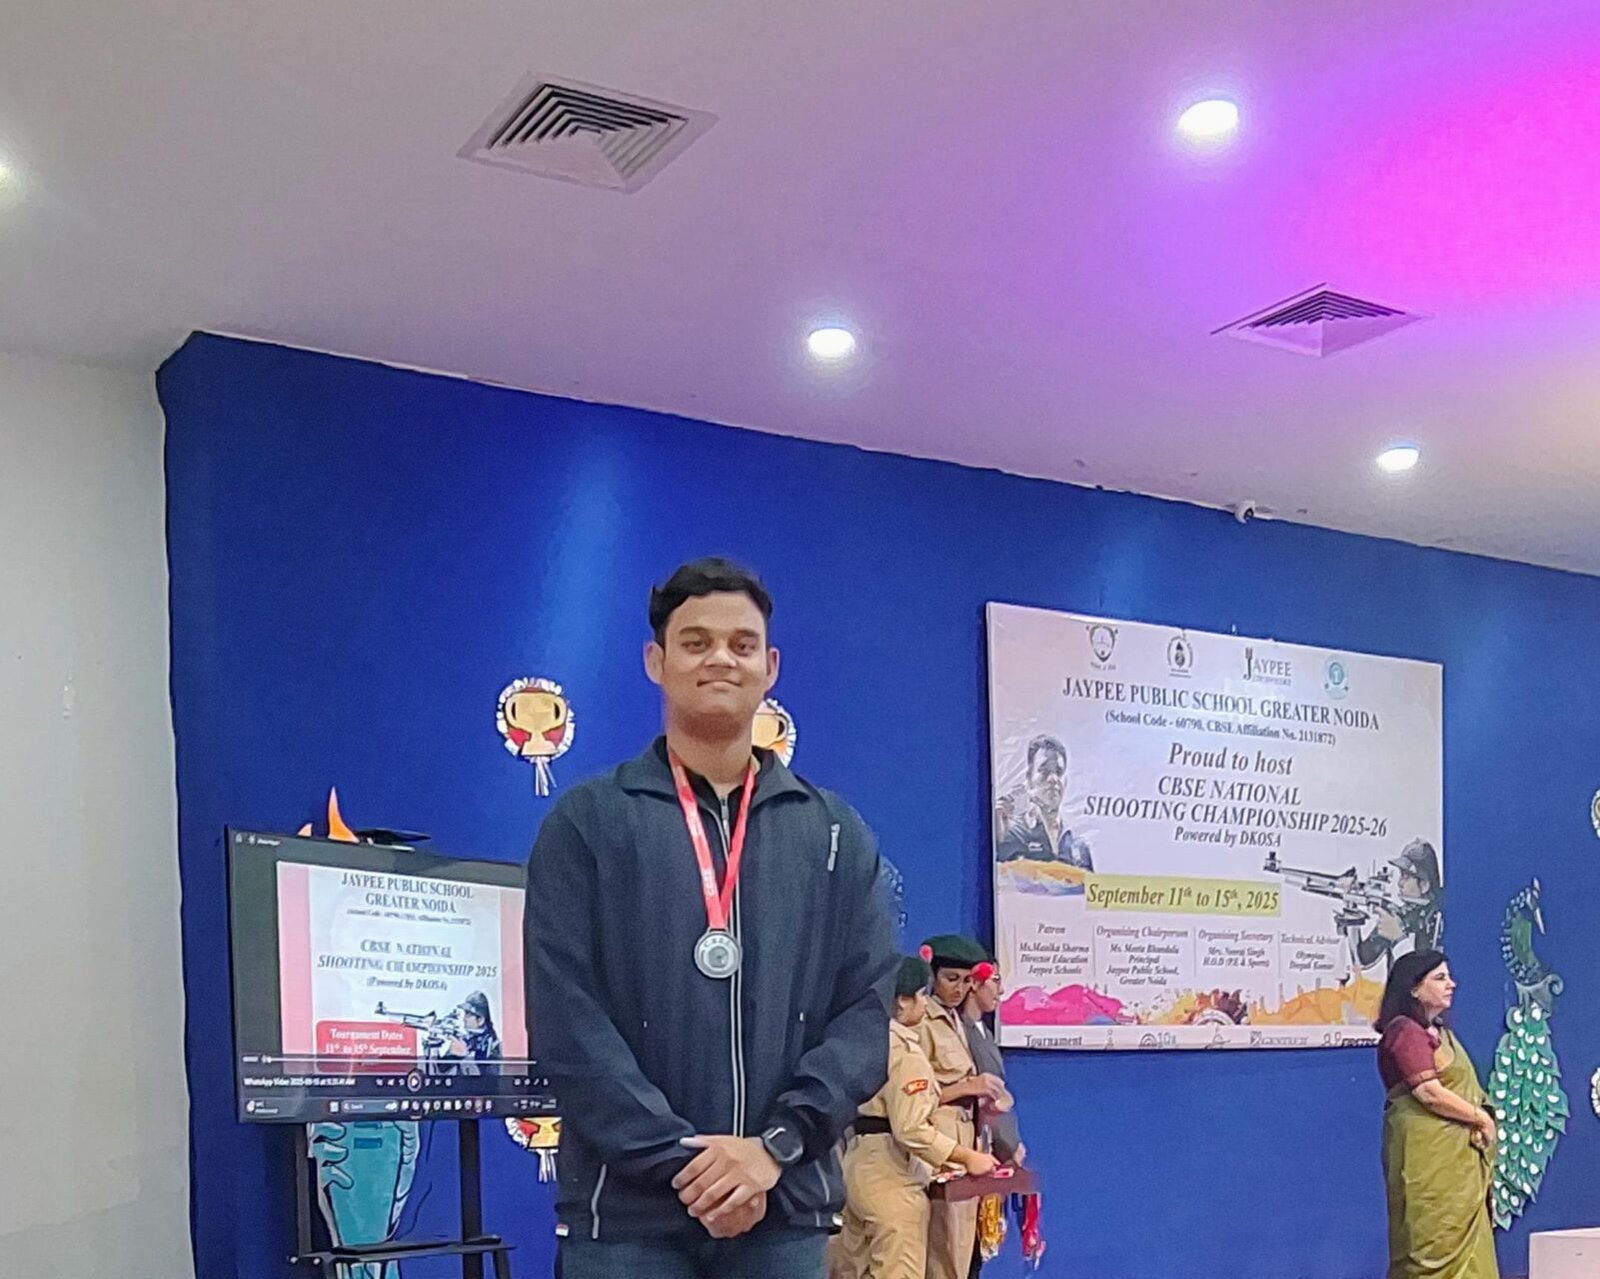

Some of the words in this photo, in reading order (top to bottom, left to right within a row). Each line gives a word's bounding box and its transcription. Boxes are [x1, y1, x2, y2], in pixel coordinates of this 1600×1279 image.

[1243, 648, 1292, 680] JAYPEE
[1062, 676, 1127, 702] JAYPEE
[1130, 684, 1189, 709] PUBLIC
[1192, 691, 1257, 716] SCHOOL
[1260, 699, 1330, 725] GREATER
[1333, 707, 1379, 730] NOIDA
[1105, 709, 1140, 725] (School
[1143, 713, 1167, 727] Code
[1207, 720, 1234, 734] CBSE
[1236, 723, 1280, 738] Affiliation
[1282, 728, 1297, 740] No.
[1169, 742, 1227, 769] Proud
[1231, 751, 1249, 771] to
[1254, 750, 1293, 775] host
[1158, 775, 1207, 798] CBSE
[1209, 780, 1301, 806] NATIONAL
[1083, 795, 1187, 821] SHOOTING
[1191, 804, 1329, 831] CHAMPIONSHIP
[1331, 814, 1388, 837] 2025-26
[1175, 826, 1222, 843] Powered
[1224, 828, 1237, 848] by
[1239, 830, 1281, 847] DKOSA
[341, 872, 385, 890] JAYPEE
[387, 878, 428, 895] PUBLIC
[430, 882, 474, 900] SCHOOL
[1088, 883, 1164, 909] September
[1168, 886, 1193, 906] 11th
[1196, 891, 1210, 907] to
[1245, 890, 1279, 910] 2025
[365, 892, 420, 910] GREATER
[422, 898, 457, 914] NOIDA
[1037, 923, 1065, 934] Patron
[317, 955, 383, 971] SHOOTING
[475, 965, 498, 978] 2025
[1020, 954, 1051, 963] Director
[1052, 954, 1089, 964] Education
[1128, 954, 1160, 967] Principal
[404, 978, 414, 990] by
[329, 1028, 380, 1040] Tournament
[381, 1029, 404, 1041] Dates
[1024, 1034, 1083, 1048] Tournament
